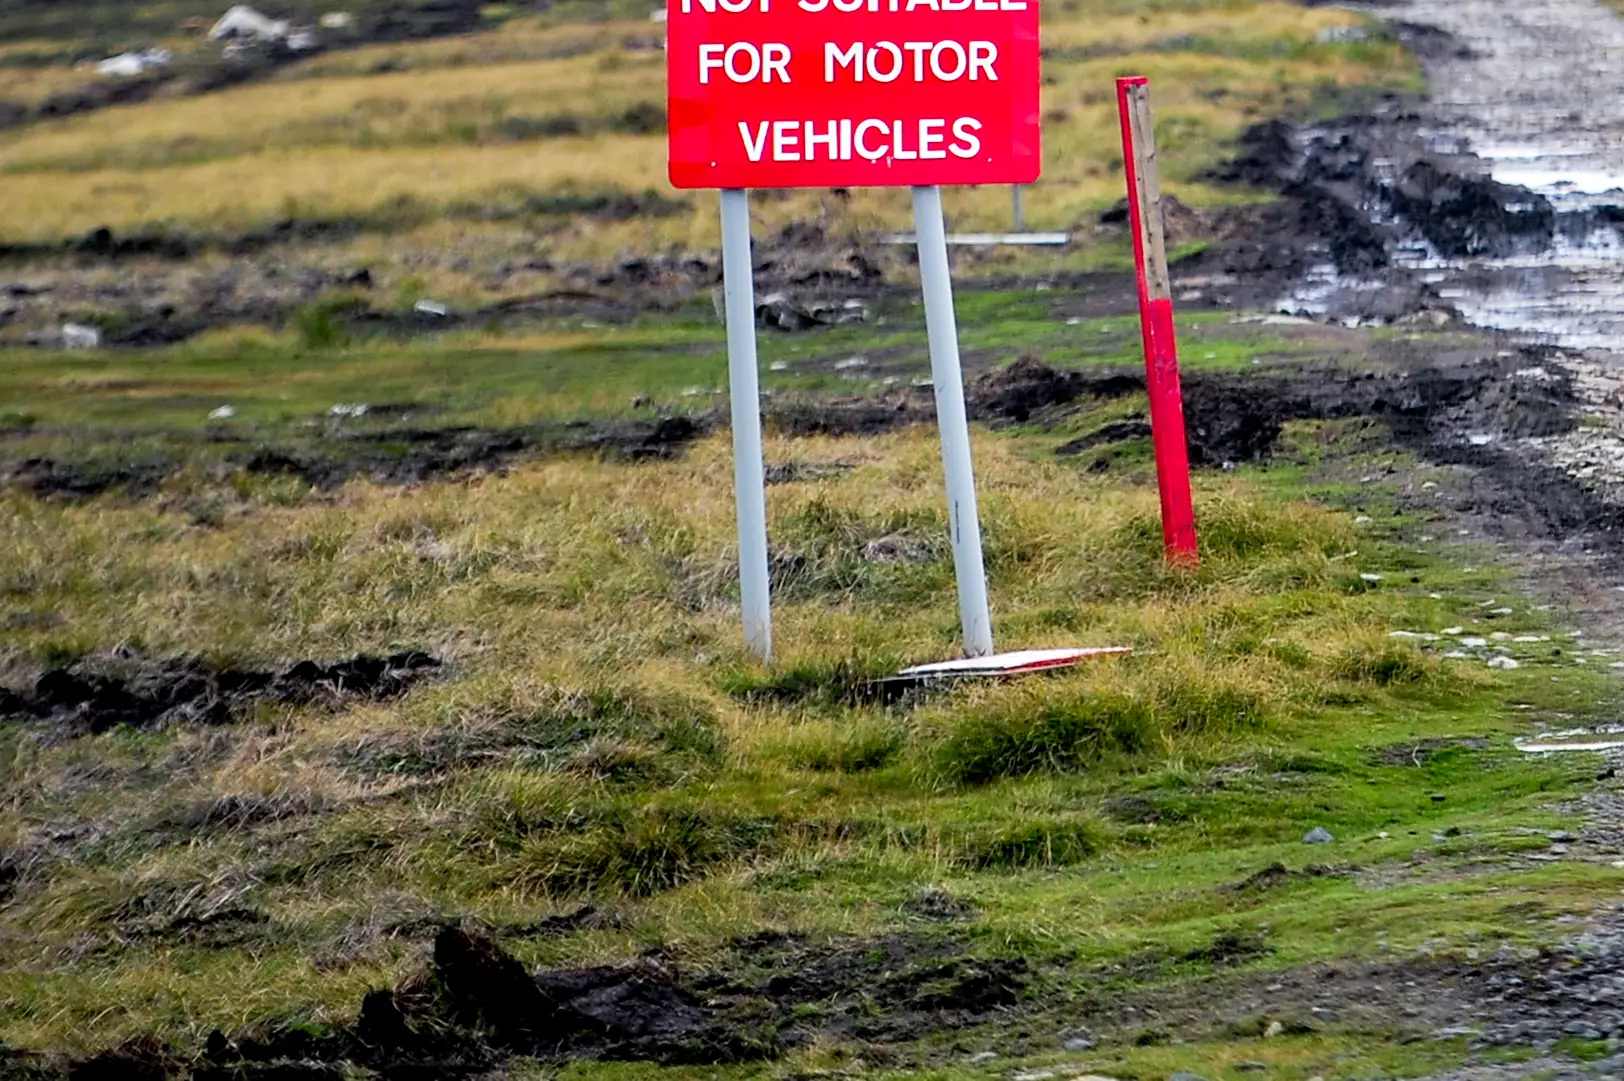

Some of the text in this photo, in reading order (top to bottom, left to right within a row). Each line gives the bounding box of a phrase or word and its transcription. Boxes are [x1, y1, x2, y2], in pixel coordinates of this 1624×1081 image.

[698, 40, 999, 84] FOR MOTOR
[738, 116, 983, 162] VEHICLES
